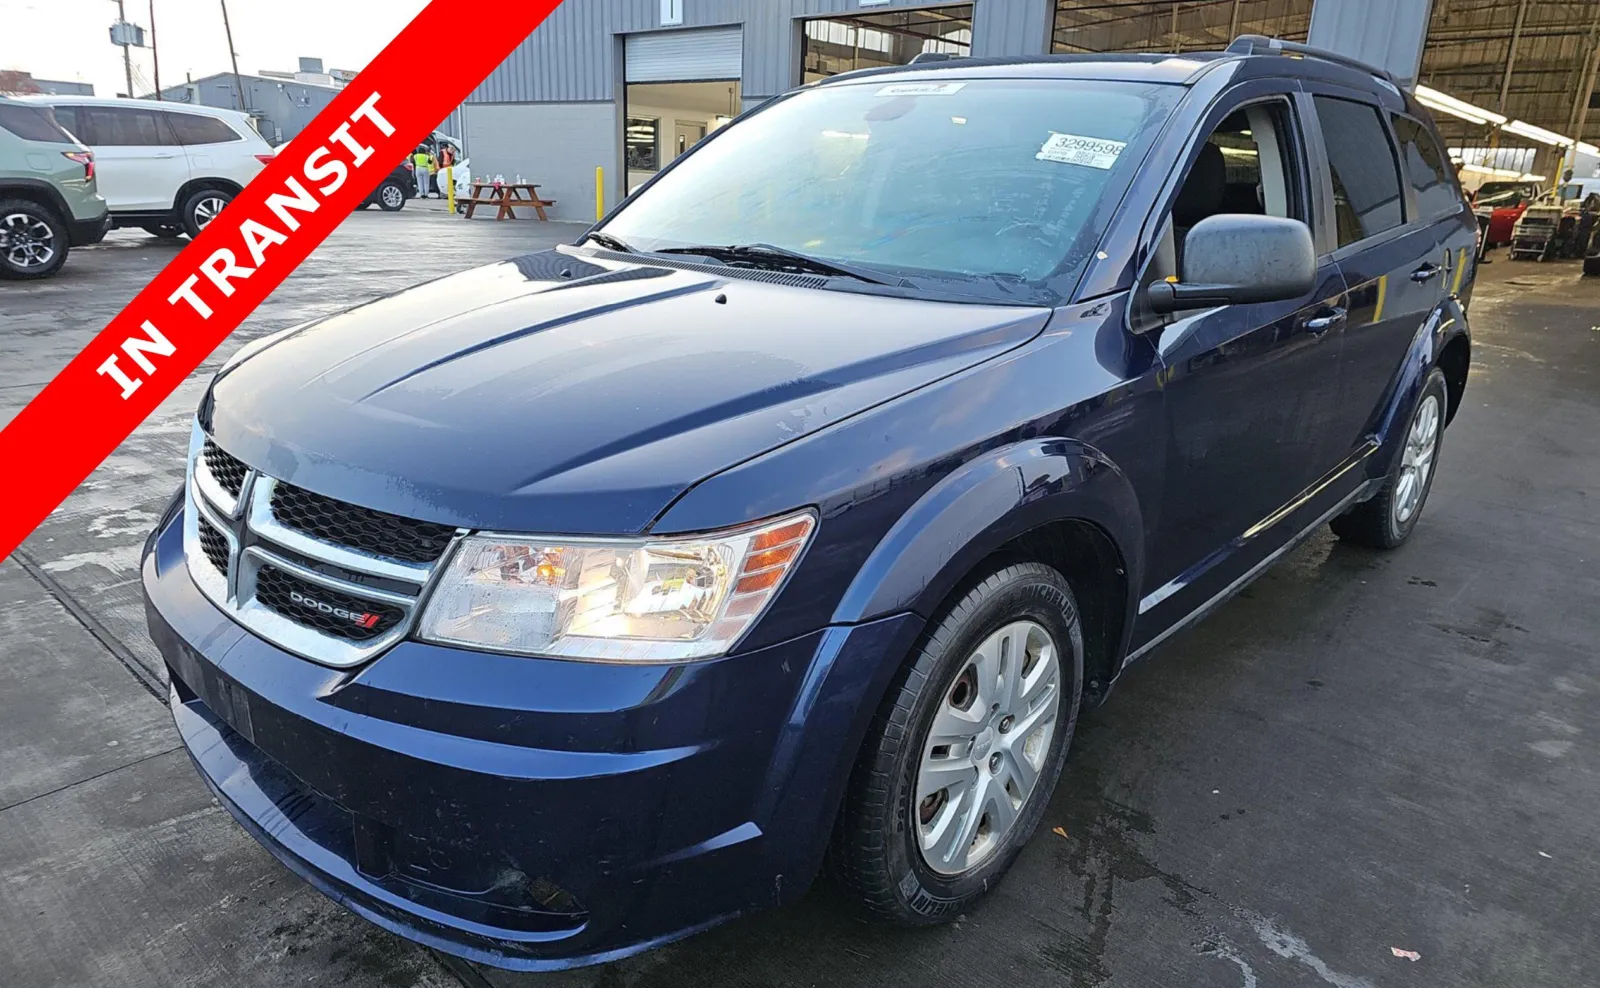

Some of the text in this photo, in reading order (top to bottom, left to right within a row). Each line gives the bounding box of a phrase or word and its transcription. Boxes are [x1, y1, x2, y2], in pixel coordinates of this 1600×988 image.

[1055, 137, 1125, 156] 3299598
[290, 591, 365, 623] DODGE
[1019, 583, 1076, 628] MICHELIN
